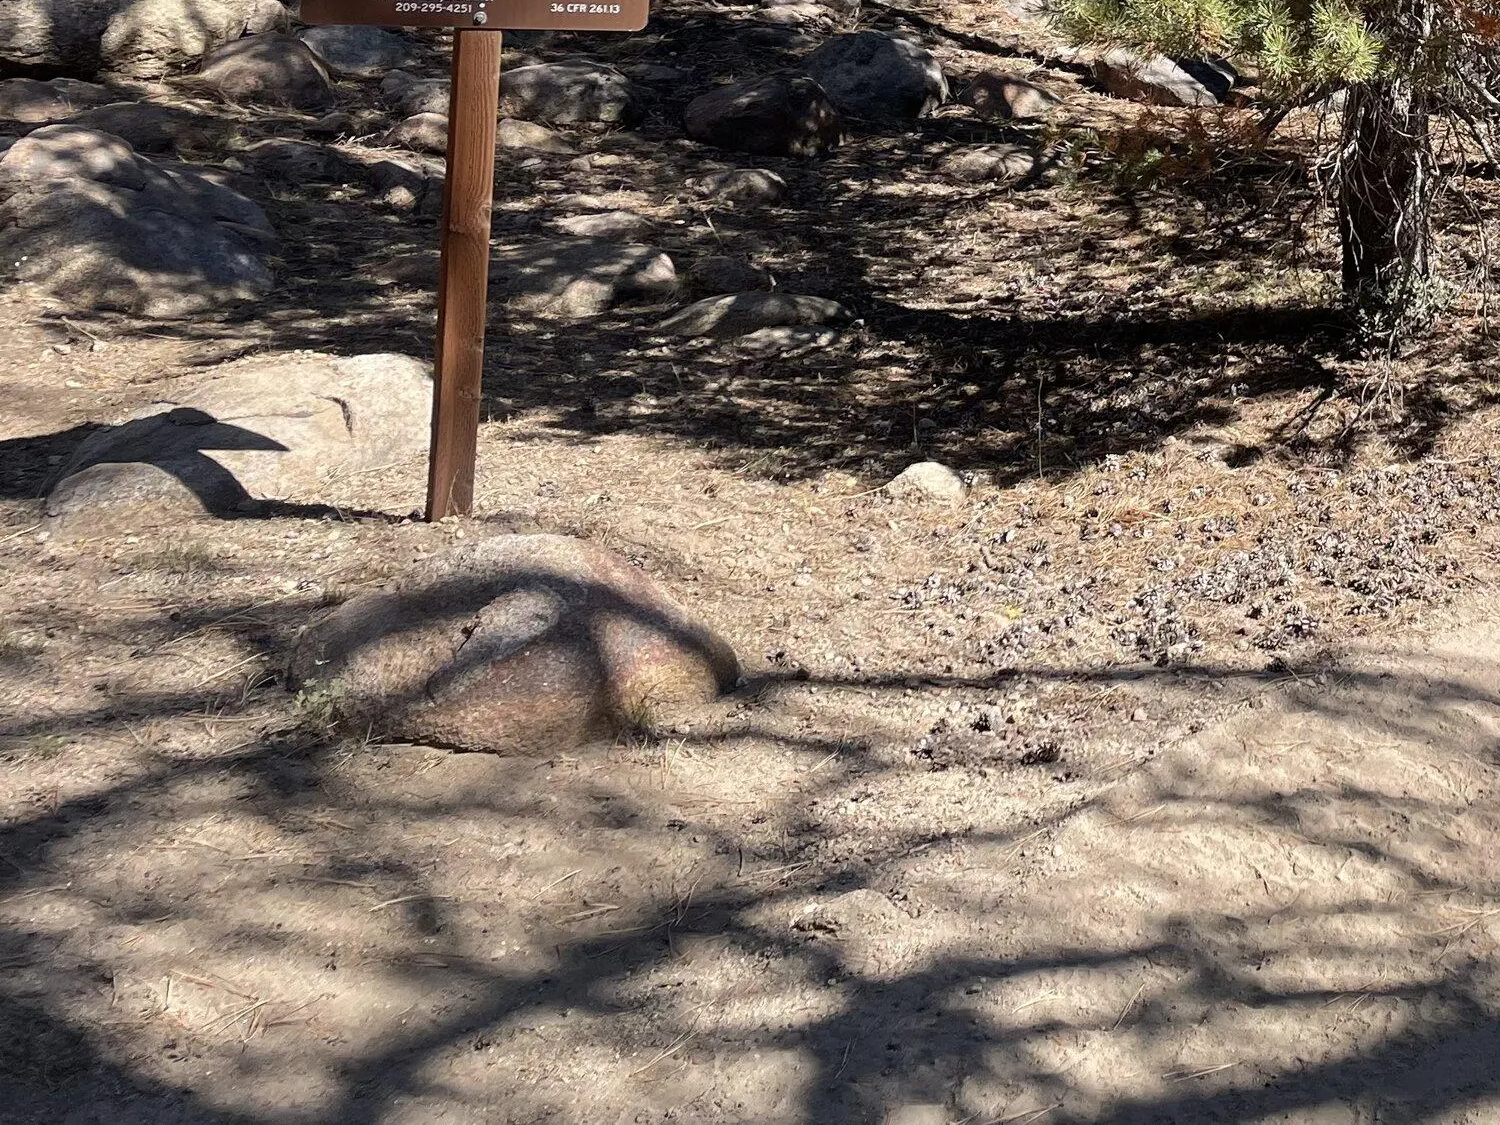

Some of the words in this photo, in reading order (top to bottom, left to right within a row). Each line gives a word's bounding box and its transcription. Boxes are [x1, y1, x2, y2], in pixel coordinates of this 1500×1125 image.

[396, 2, 472, 13] 209-295-4251
[550, 2, 564, 13] 36
[567, 3, 587, 13] CFR
